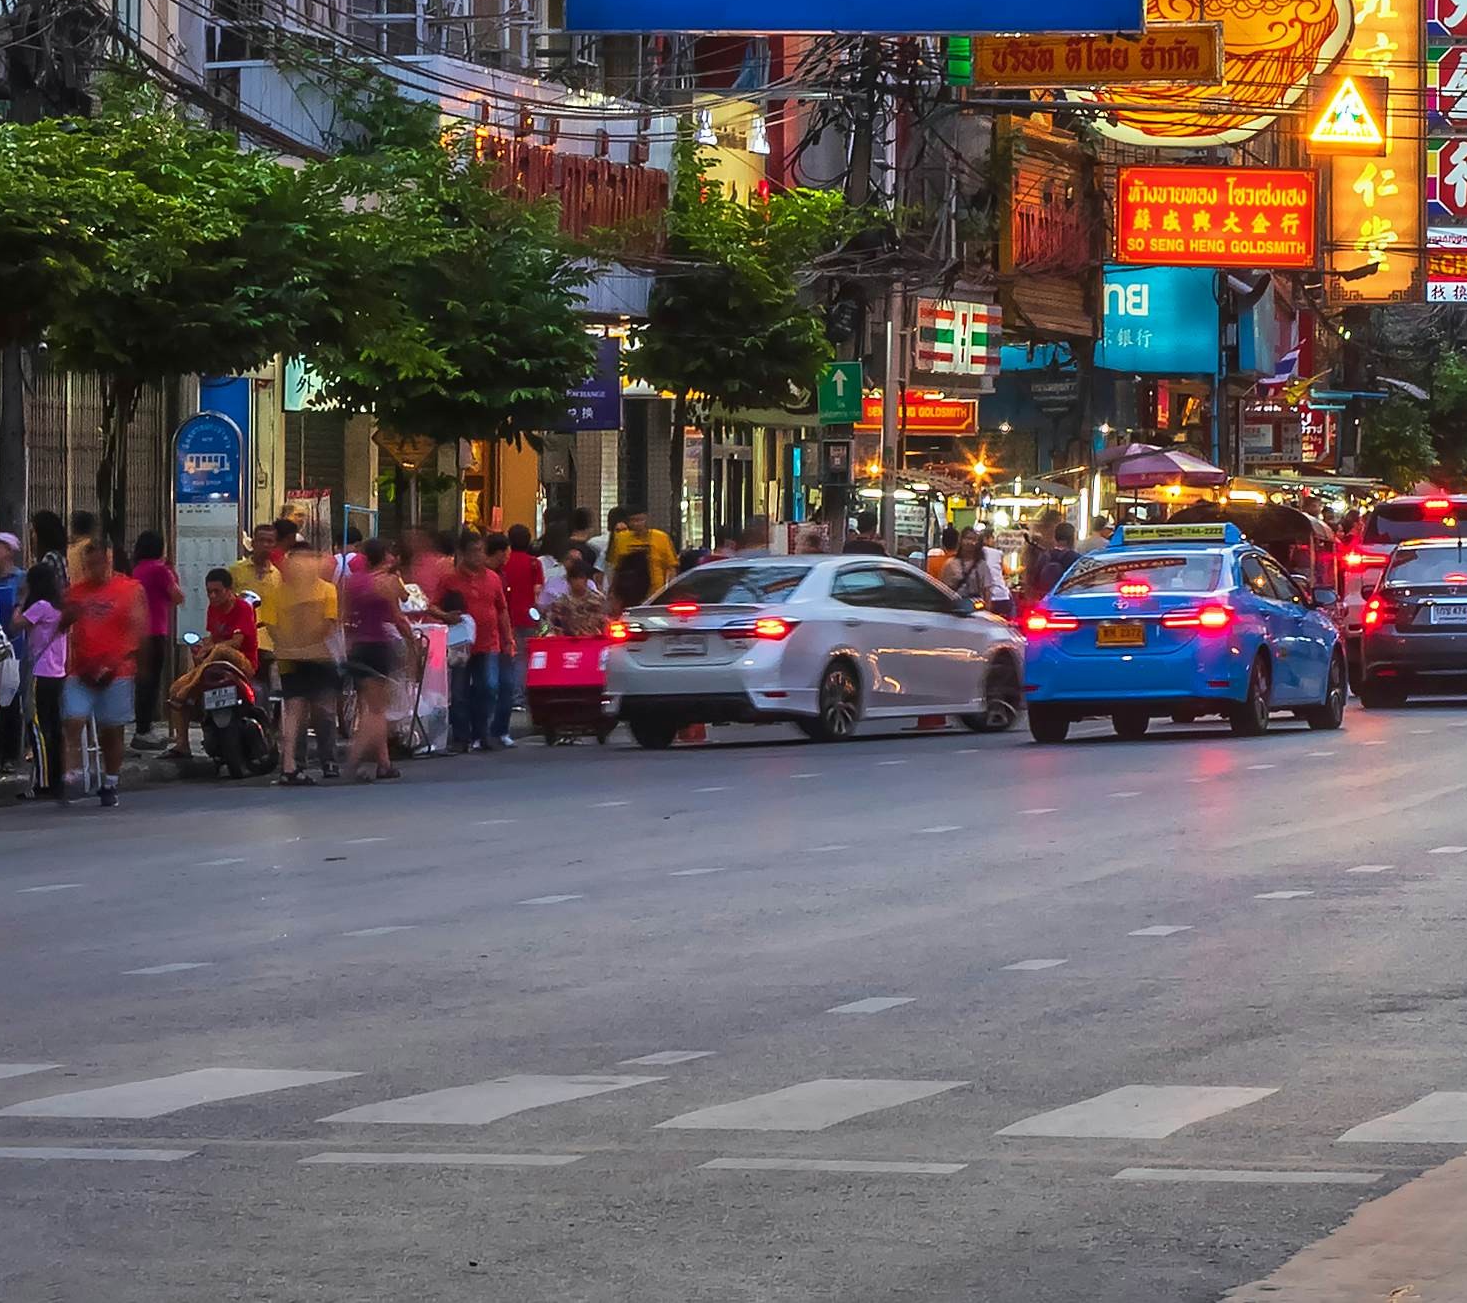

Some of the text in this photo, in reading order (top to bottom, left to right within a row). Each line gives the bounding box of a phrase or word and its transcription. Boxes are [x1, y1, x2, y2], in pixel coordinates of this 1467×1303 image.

[991, 40, 1055, 75] บริษัท
[1138, 37, 1200, 74] จำกัด
[1126, 236, 1306, 255] SO SENG HENG GOLDSMITH
[867, 405, 883, 418] SEN
